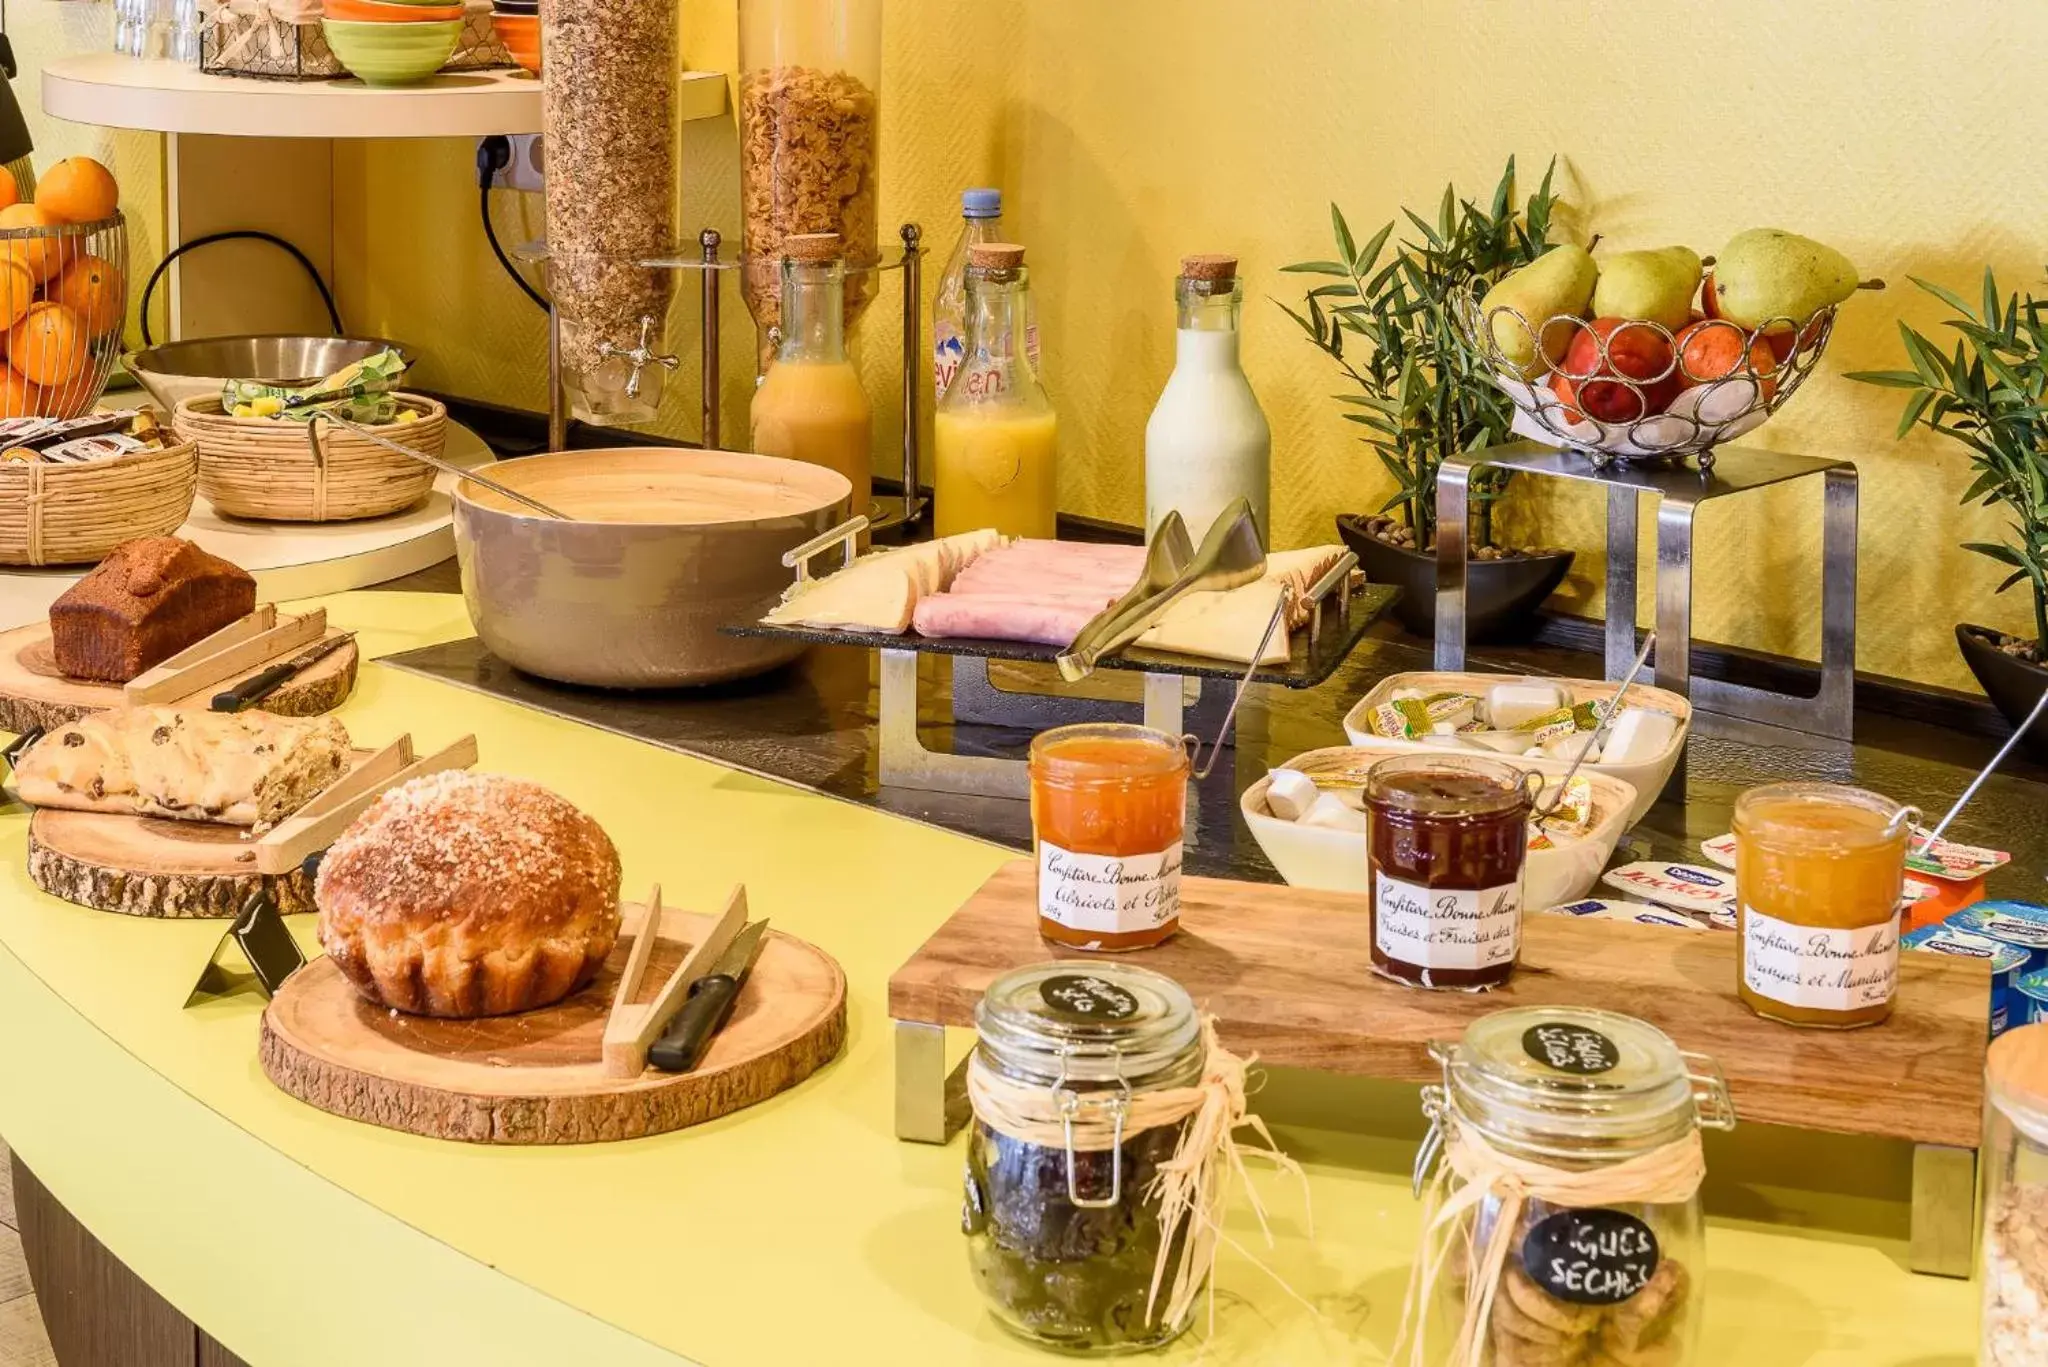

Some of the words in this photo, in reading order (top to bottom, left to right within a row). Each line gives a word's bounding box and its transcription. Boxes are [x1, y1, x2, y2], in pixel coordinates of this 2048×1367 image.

[1047, 850, 1098, 884] Confiture
[1103, 861, 1149, 885] Bonne
[1054, 886, 1117, 912] Abricots
[1122, 893, 1137, 911] et
[1613, 870, 1731, 900] Jockey
[1380, 883, 1428, 917] Confiture
[1435, 896, 1484, 920] Bonne
[1423, 932, 1437, 944] et
[1438, 927, 1490, 945] Fraises
[1748, 918, 1800, 955] Confiture
[1808, 934, 1858, 958] Bonne
[1808, 974, 1825, 987] et
